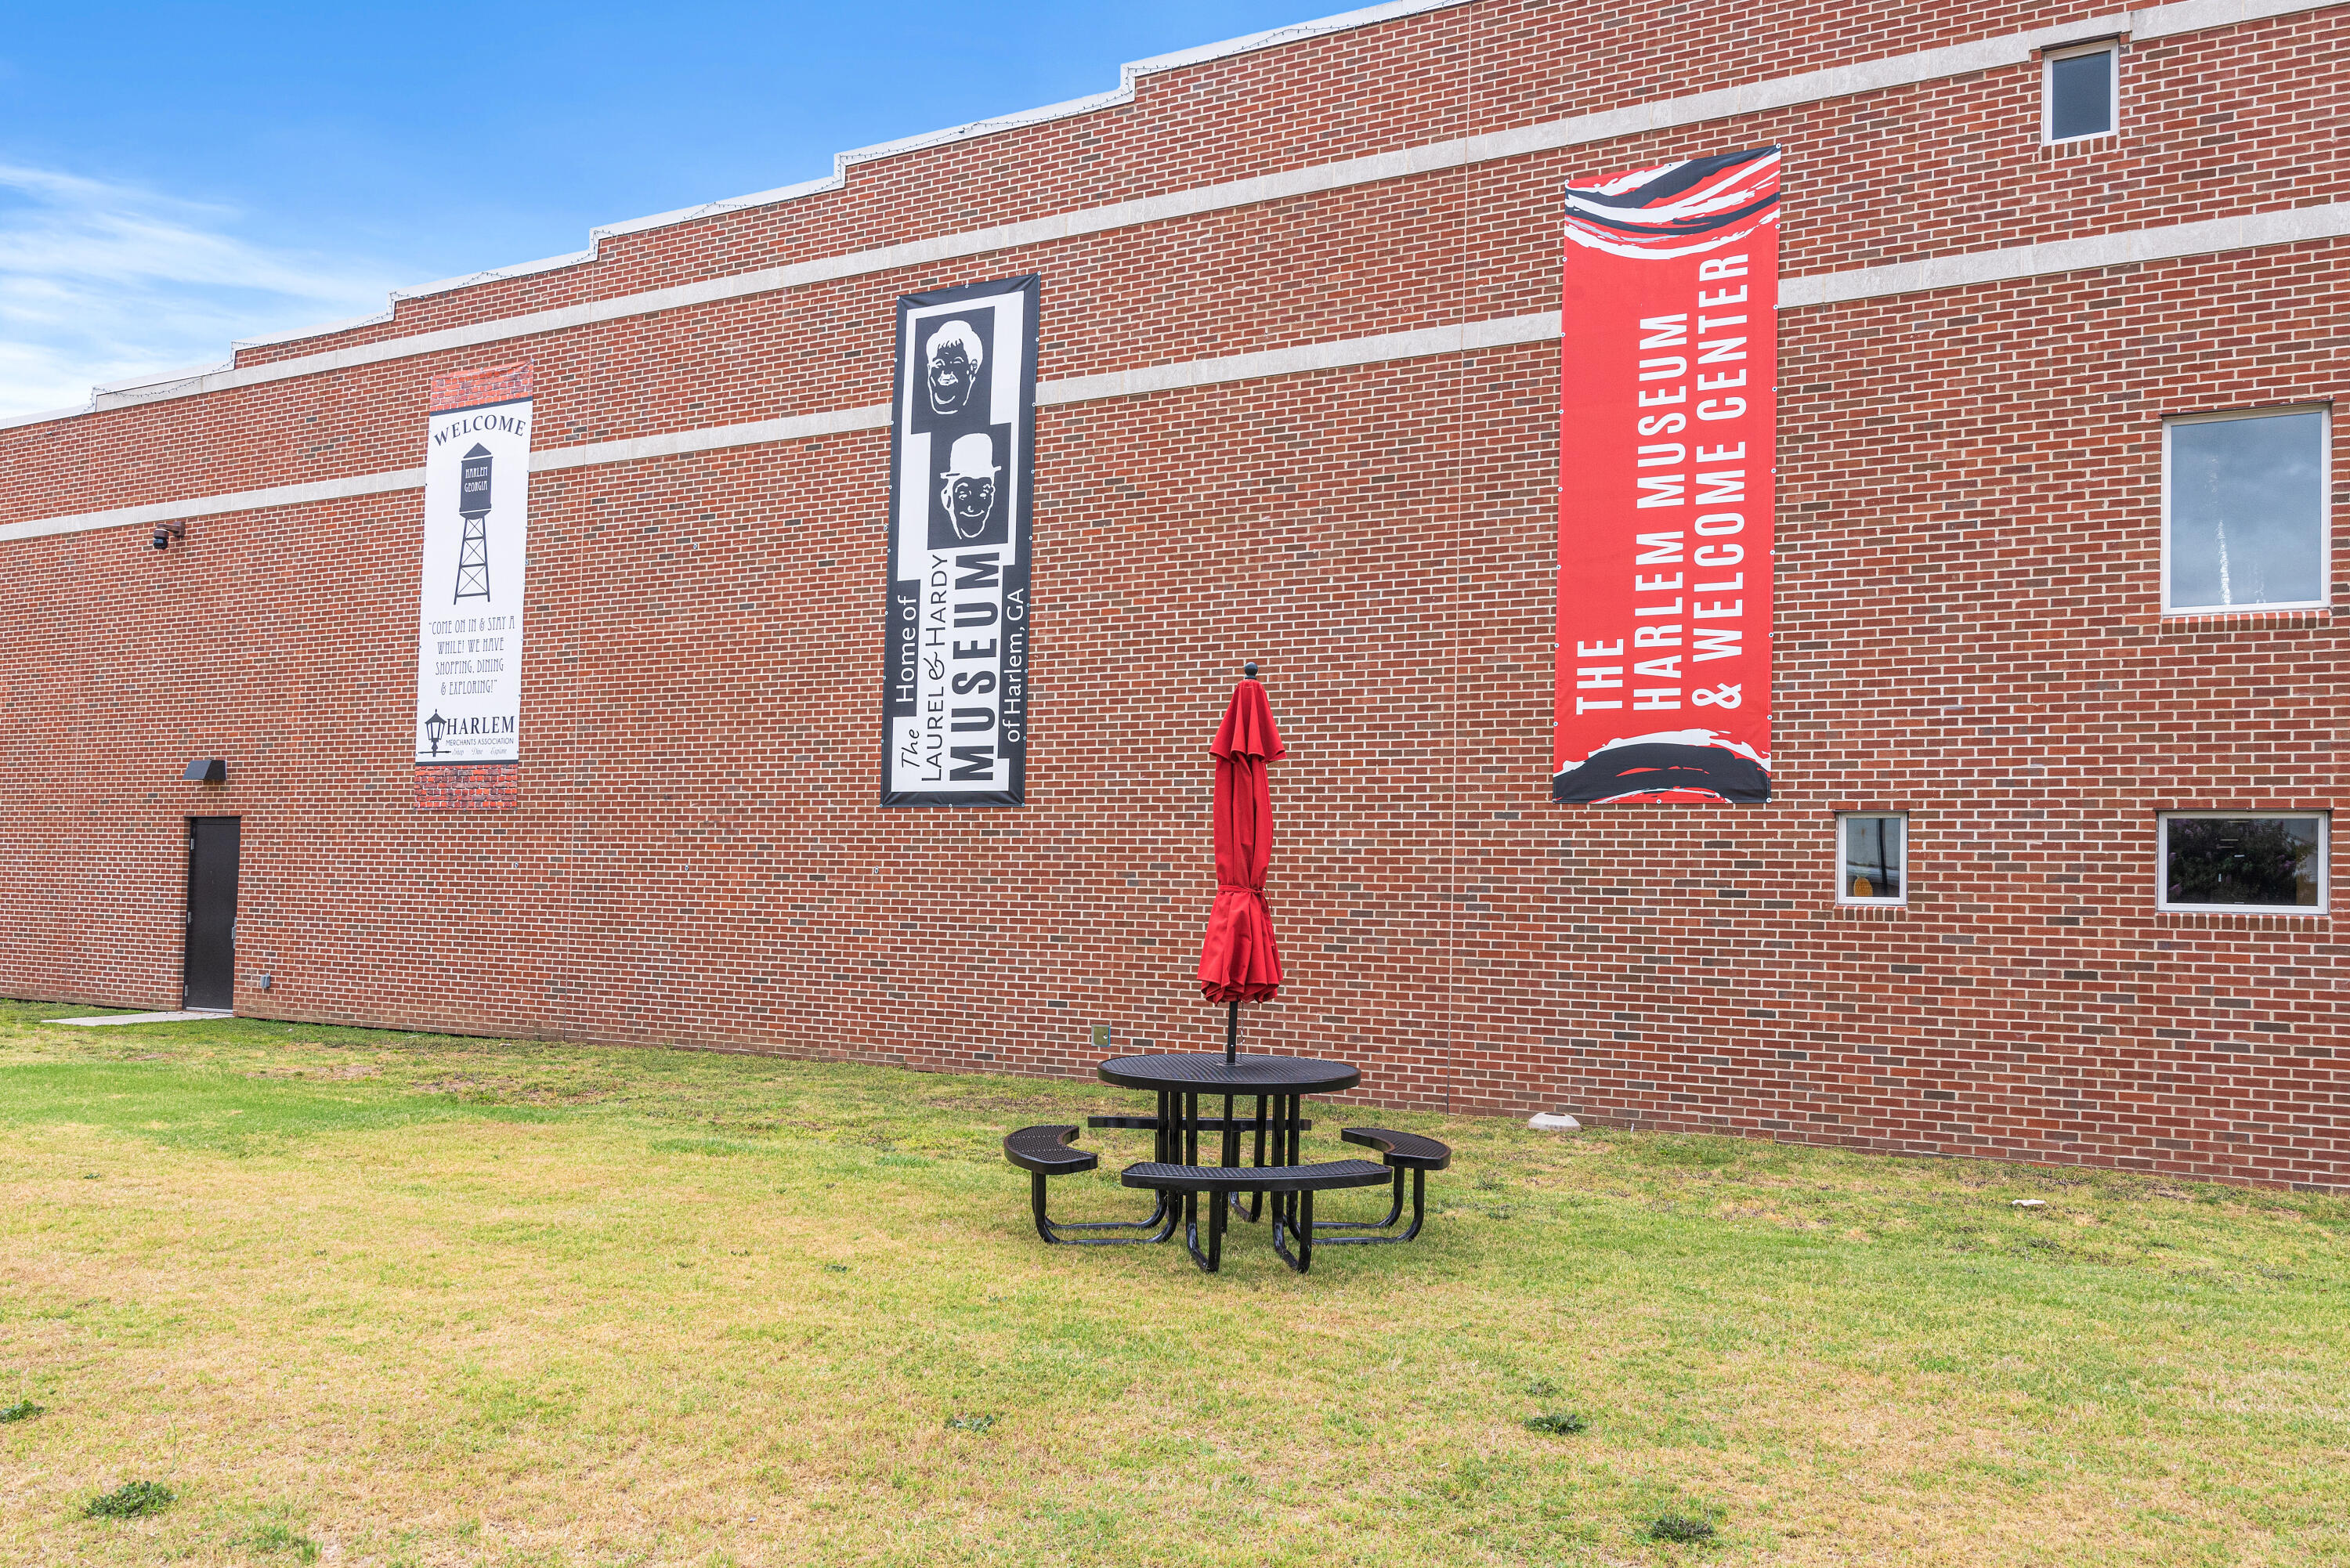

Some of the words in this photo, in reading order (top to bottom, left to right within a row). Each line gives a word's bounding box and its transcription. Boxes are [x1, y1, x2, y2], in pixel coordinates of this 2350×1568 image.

[1696, 252, 1748, 420] CENTER
[1636, 313, 1688, 509] MUSEUM
[433, 414, 526, 446] WELCOME
[464, 480, 488, 493] GEORGIA
[465, 466, 488, 479] HARLEM
[1693, 441, 1746, 663] WELCOME
[897, 595, 917, 621] of
[925, 554, 948, 646] HARDY
[1007, 587, 1024, 621] GA
[454, 620, 465, 633] ON
[468, 619, 476, 632] IN
[479, 618, 485, 631] &
[488, 616, 506, 631] STAY
[509, 616, 515, 629] A
[1633, 530, 1685, 711] HARLEM
[437, 640, 465, 655] WHILE!
[468, 639, 480, 652] WE
[483, 638, 504, 652] HAVE
[477, 659, 504, 673] DINING
[895, 627, 917, 703] Home
[924, 651, 945, 681] &
[949, 552, 1000, 781] MUSEUM
[1004, 627, 1025, 715] Harlem,
[1575, 638, 1624, 715] THE
[441, 681, 446, 695] &
[1691, 683, 1743, 709] &
[446, 716, 515, 735] HARLEM
[921, 686, 944, 782] LAUREL
[1003, 719, 1021, 742] of
[901, 728, 920, 768] The
